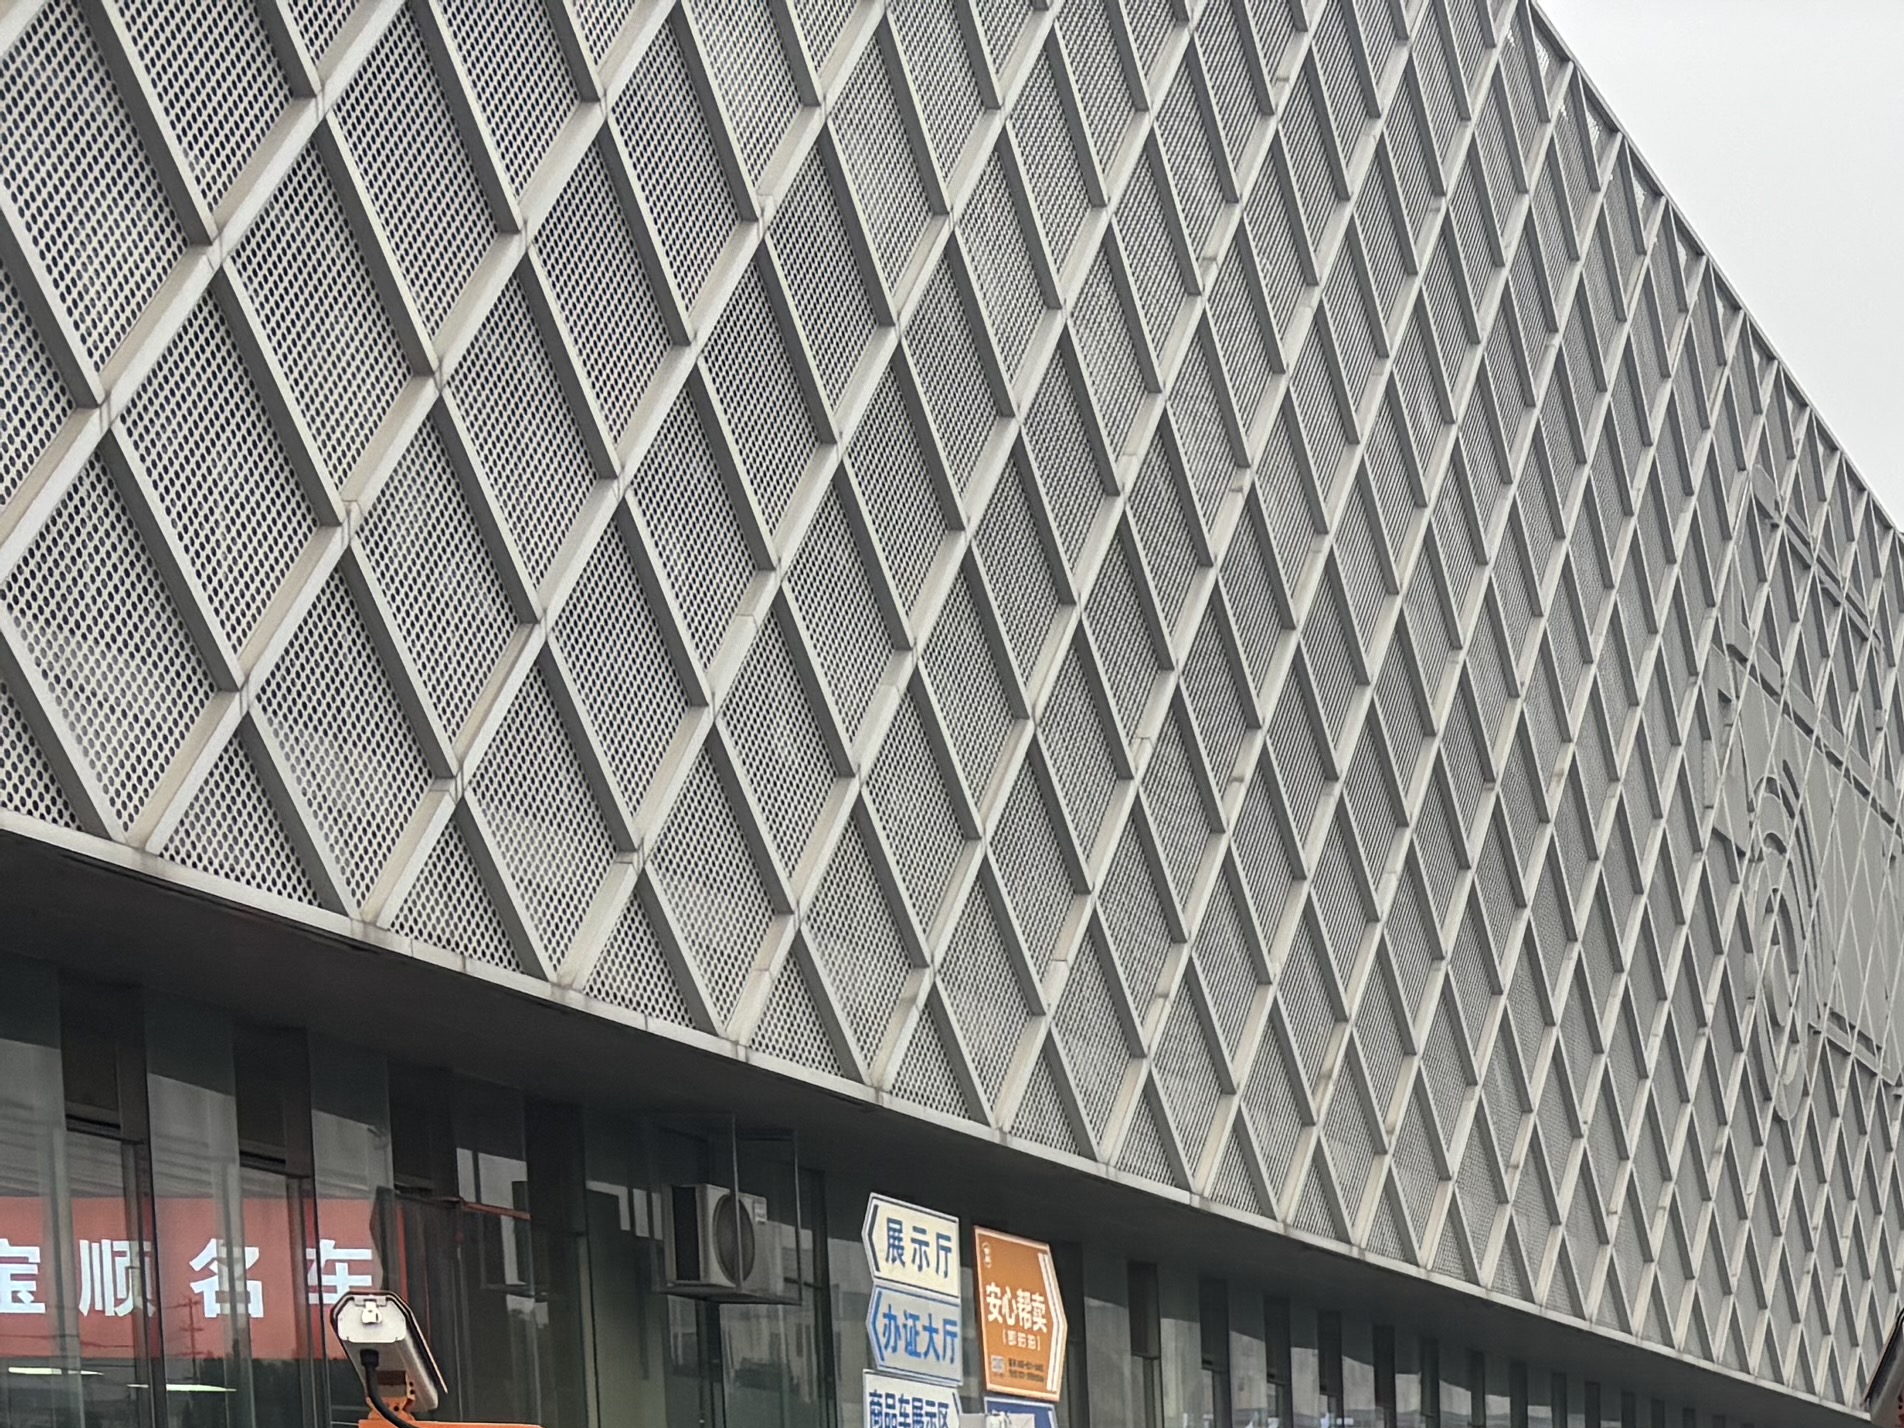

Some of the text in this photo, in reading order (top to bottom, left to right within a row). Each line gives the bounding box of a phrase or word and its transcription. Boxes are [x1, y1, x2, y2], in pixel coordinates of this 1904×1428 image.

[885, 1217, 952, 1279] 展示厅
[882, 1303, 958, 1364] 办证大厅
[985, 1282, 1048, 1333] 安心帮卖
